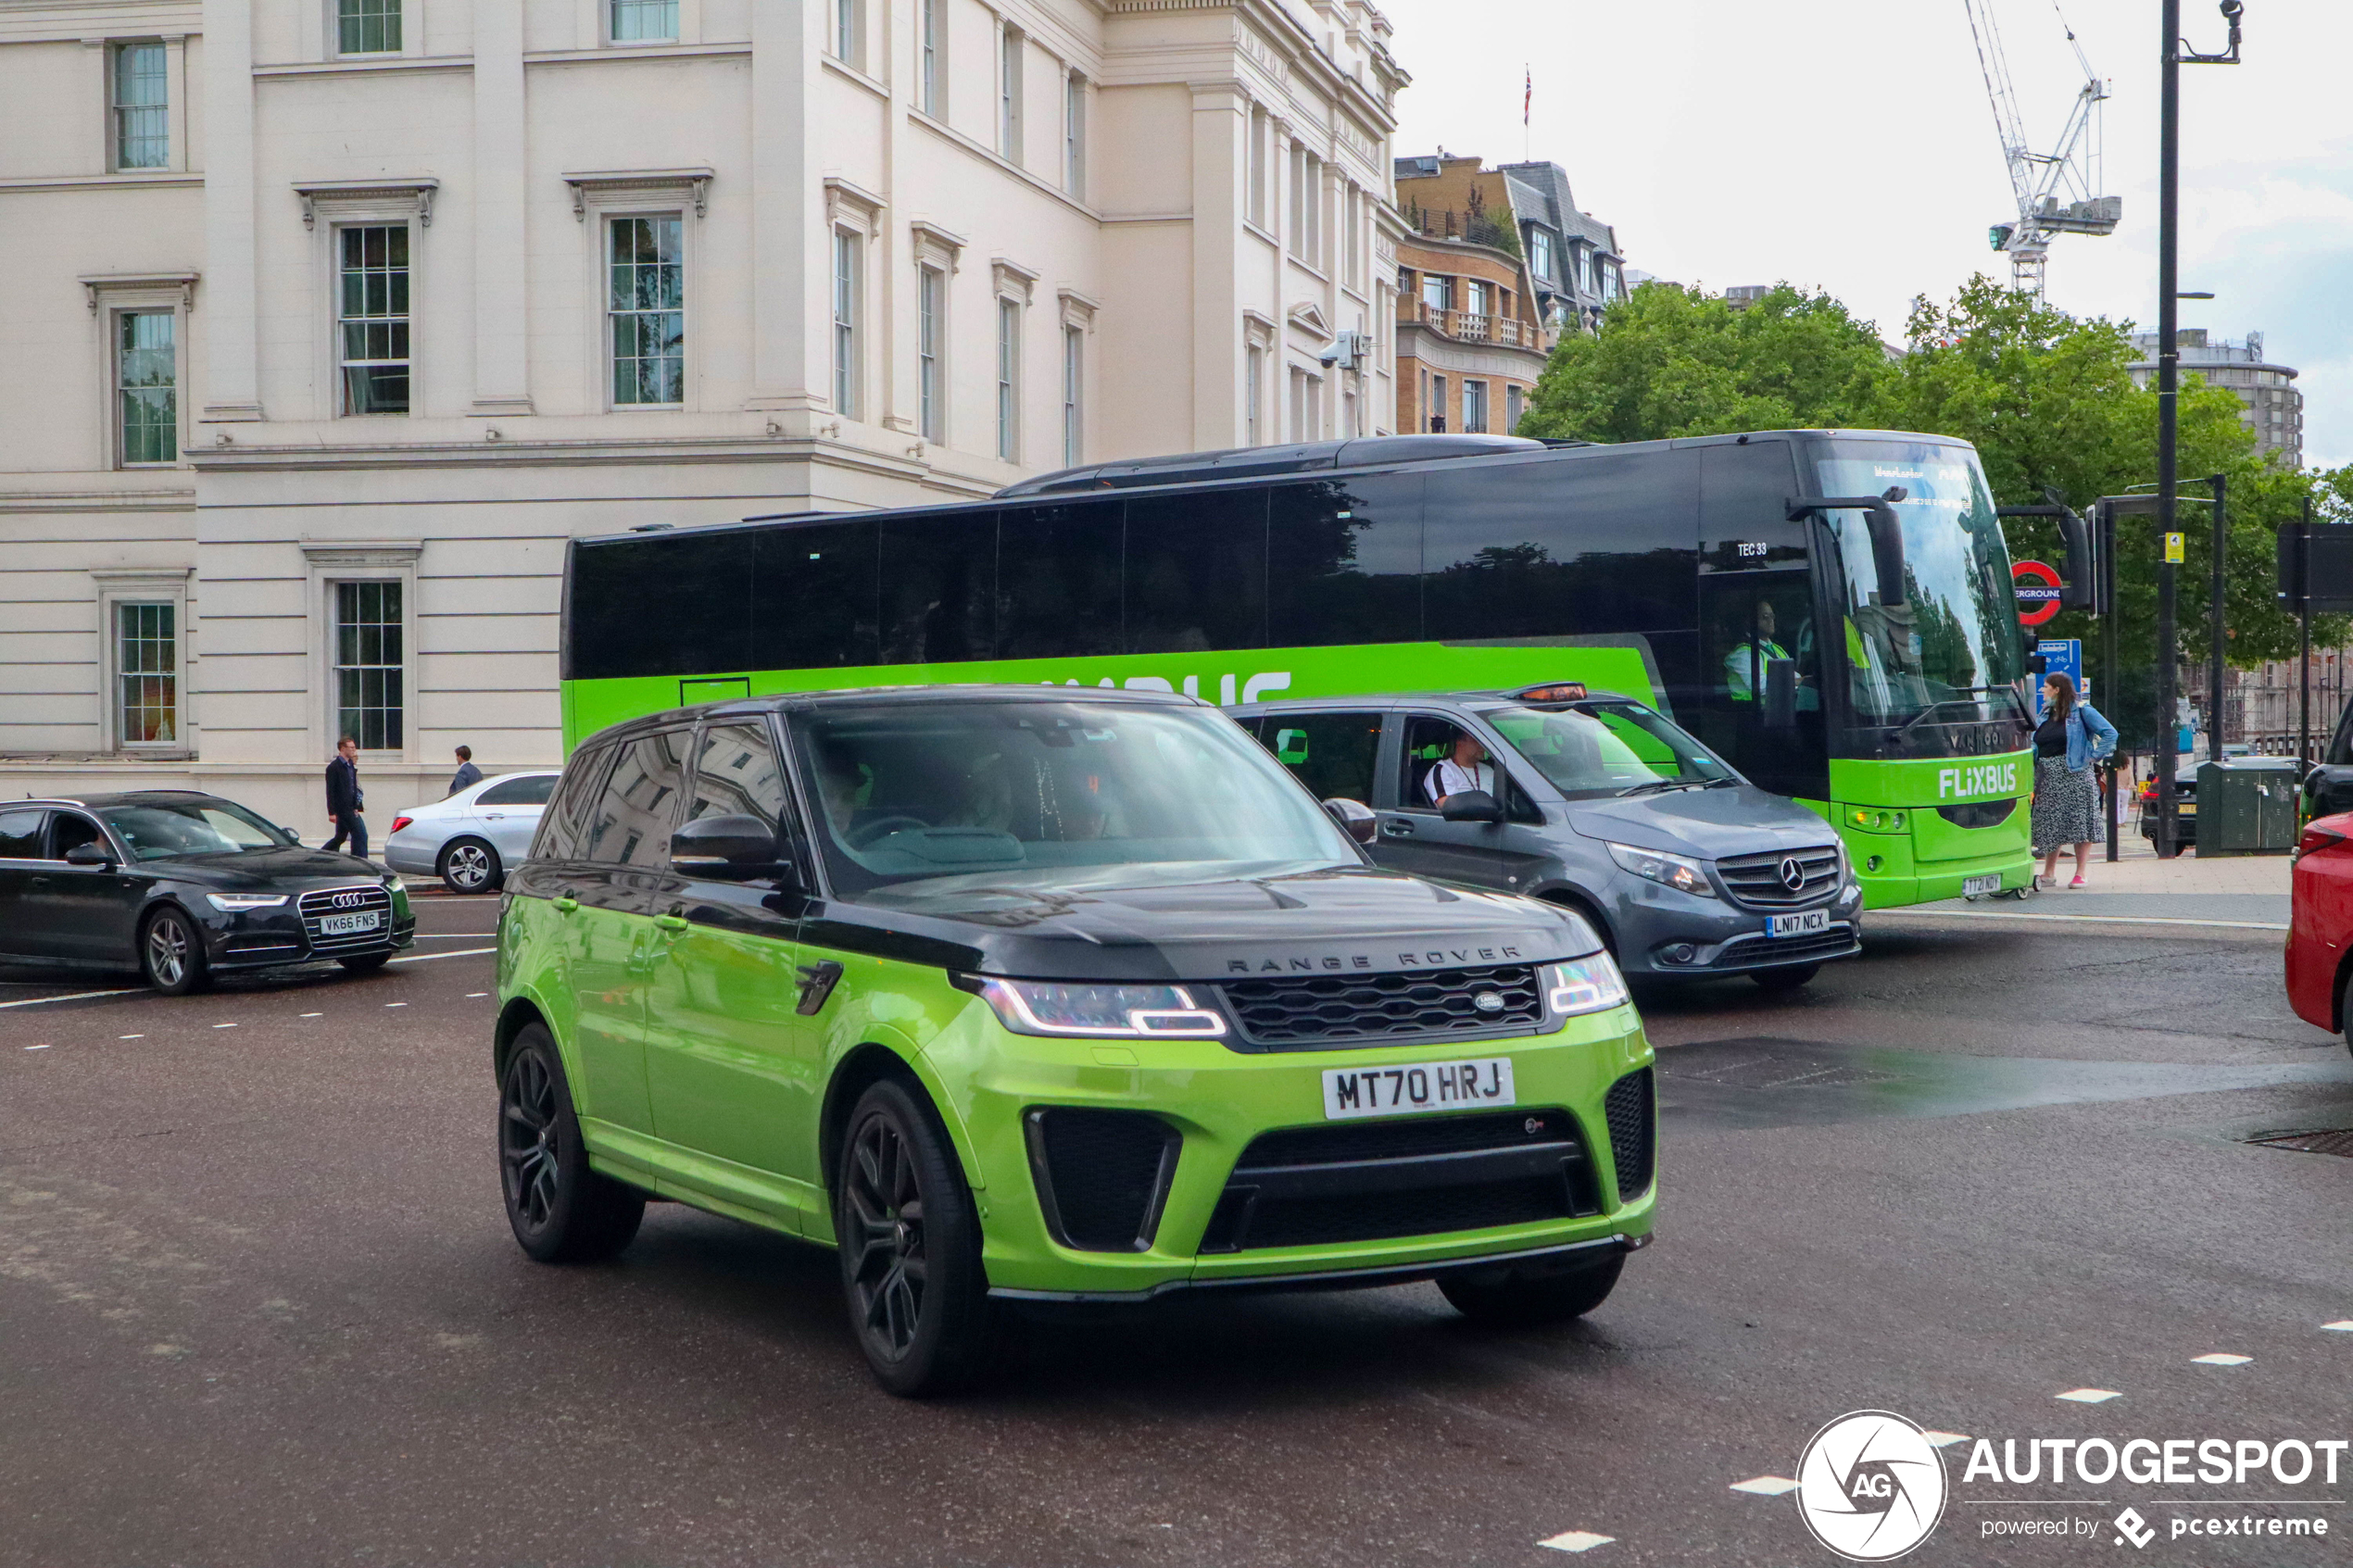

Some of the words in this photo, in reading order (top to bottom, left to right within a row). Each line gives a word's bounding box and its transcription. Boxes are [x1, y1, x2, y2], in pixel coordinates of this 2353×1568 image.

[1738, 543, 1755, 557] TEC
[1756, 542, 1767, 555] 33
[326, 917, 353, 931] VK66
[356, 914, 375, 928] FNS
[1774, 916, 1800, 933] LN17
[1804, 913, 1823, 930] NCX
[1227, 956, 1371, 972] RANGE
[1399, 947, 1521, 965] ROVER
[1337, 1069, 1428, 1110] MT70
[1438, 1063, 1501, 1101] HRJ
